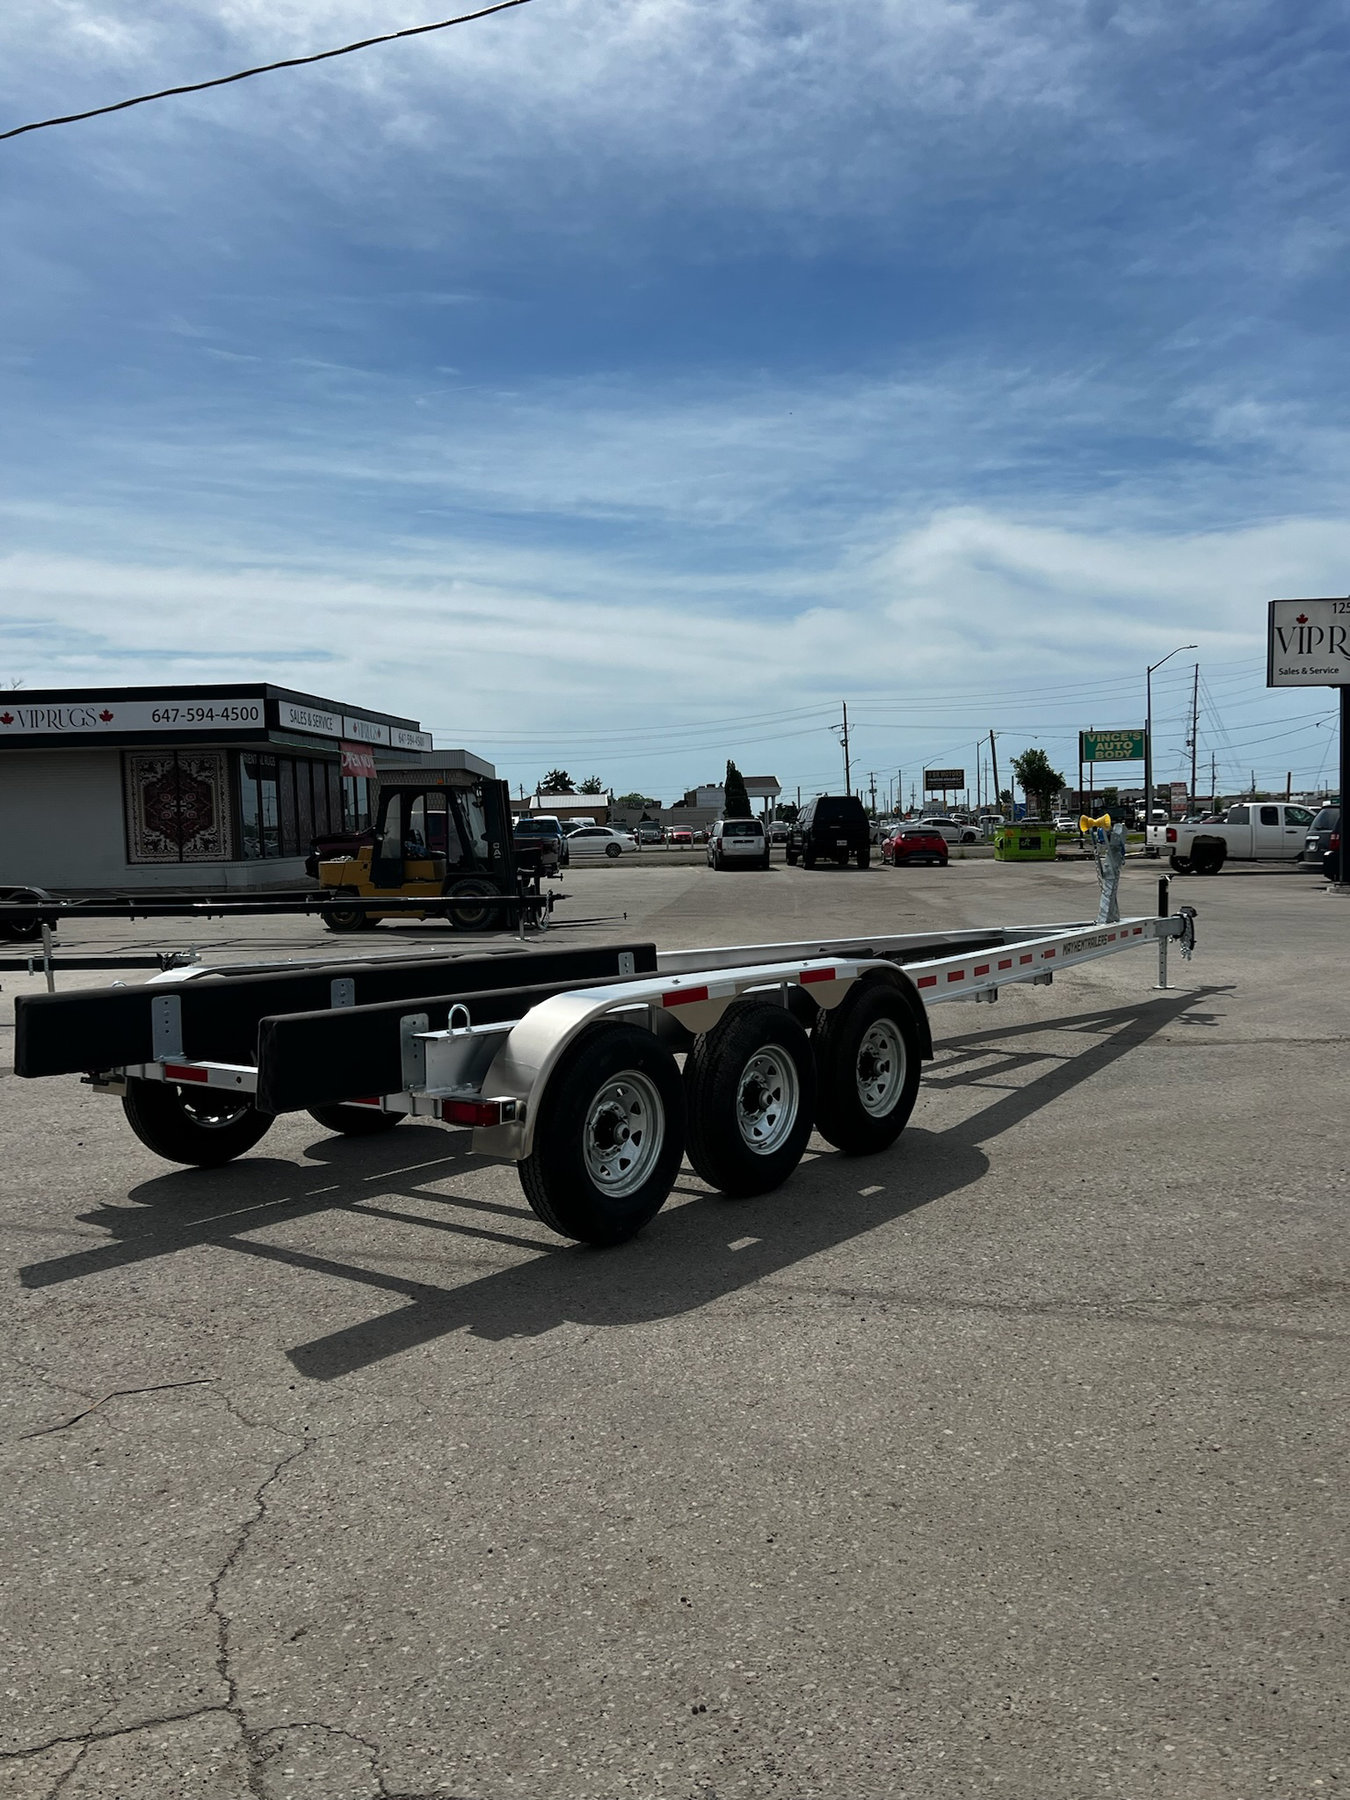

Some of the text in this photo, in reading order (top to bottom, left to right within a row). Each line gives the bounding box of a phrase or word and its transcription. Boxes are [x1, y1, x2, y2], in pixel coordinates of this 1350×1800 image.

[1275, 625, 1350, 661] VIPR
[1278, 666, 1340, 675] Sales & Service
[16, 706, 260, 731] VIPRUGS 647-594-4500
[289, 708, 333, 732] SALES & SERVICE
[1087, 732, 1142, 742] VINCE'S
[1095, 741, 1134, 750] AUTO
[341, 752, 361, 770] OPEN
[1095, 750, 1133, 759] BODY
